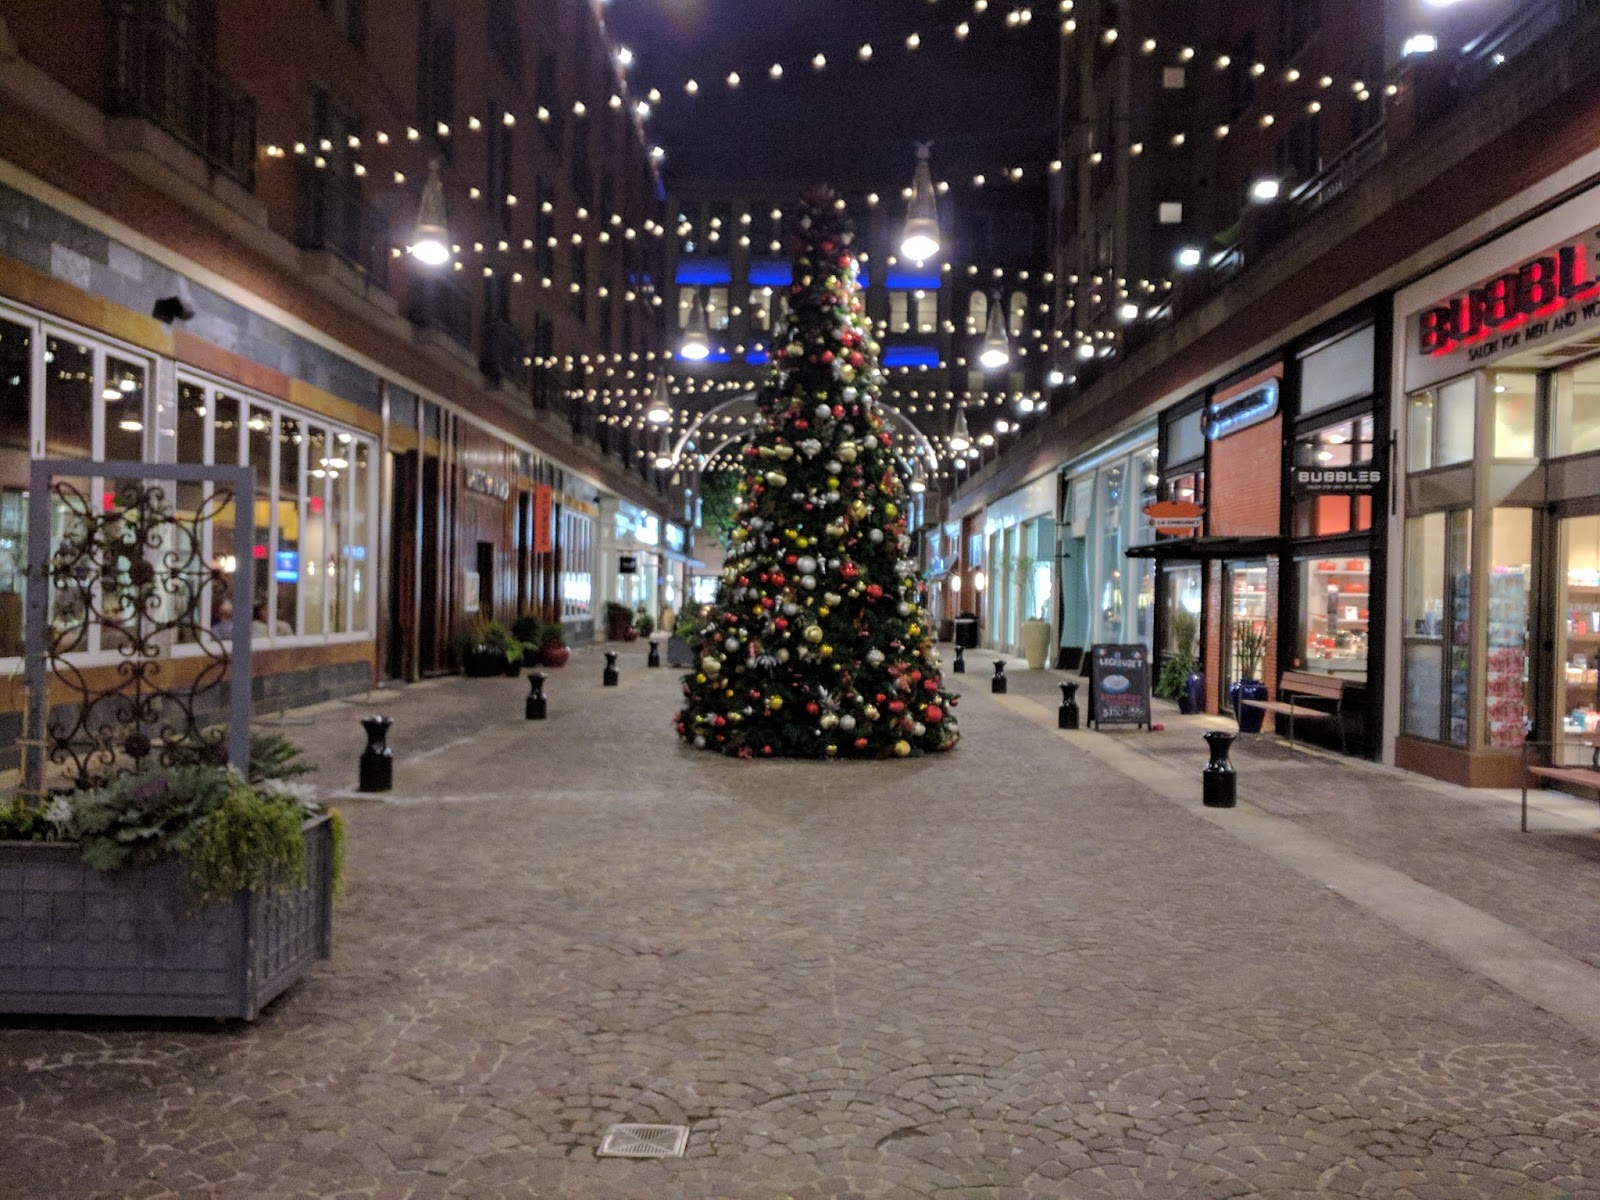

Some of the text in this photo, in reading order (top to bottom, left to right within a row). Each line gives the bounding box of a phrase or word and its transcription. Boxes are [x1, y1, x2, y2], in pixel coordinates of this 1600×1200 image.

[1419, 231, 1600, 355] BUBBL
[1468, 341, 1498, 359] SALON
[1502, 333, 1520, 349] FOR
[1525, 321, 1548, 341] MEN
[1553, 311, 1577, 333] AND
[1298, 470, 1381, 483] BUBBLES
